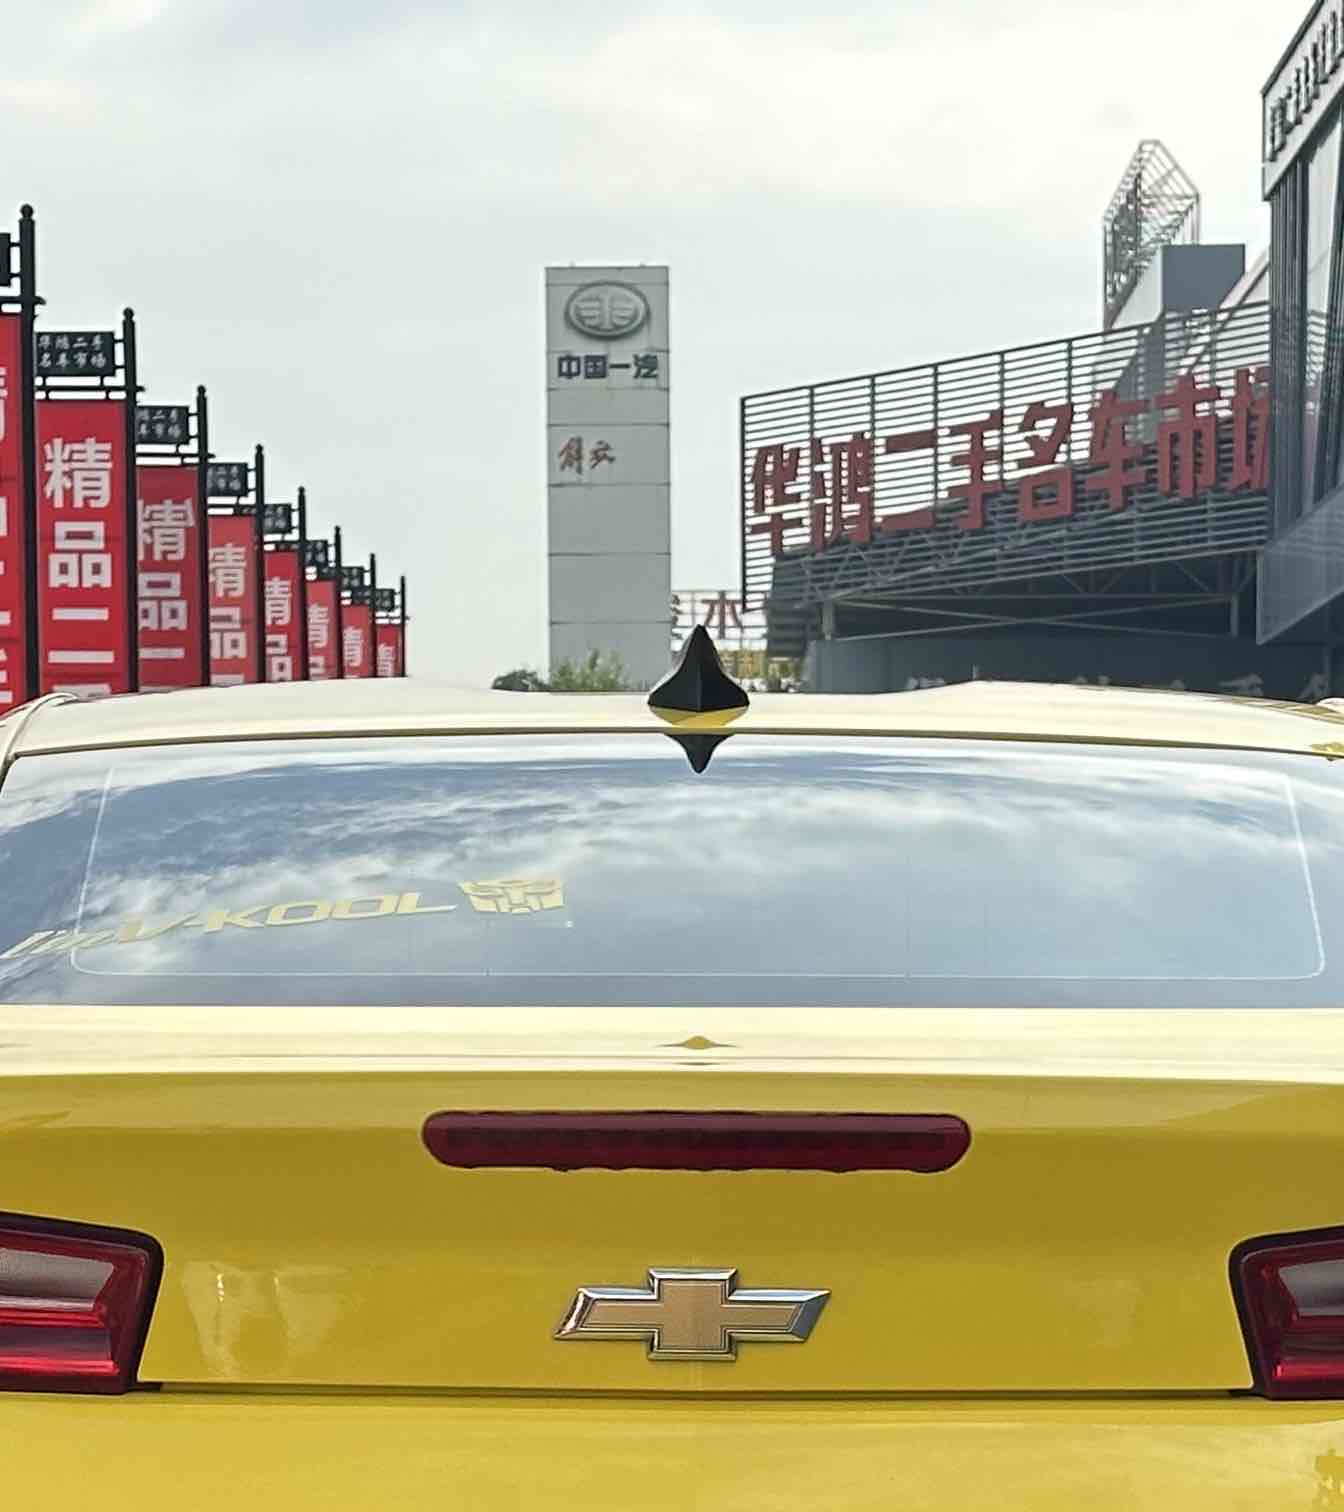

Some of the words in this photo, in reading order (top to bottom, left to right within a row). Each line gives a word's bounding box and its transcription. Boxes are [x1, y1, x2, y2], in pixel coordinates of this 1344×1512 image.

[557, 353, 659, 380] 中国一汽
[43, 437, 115, 697] 精品二
